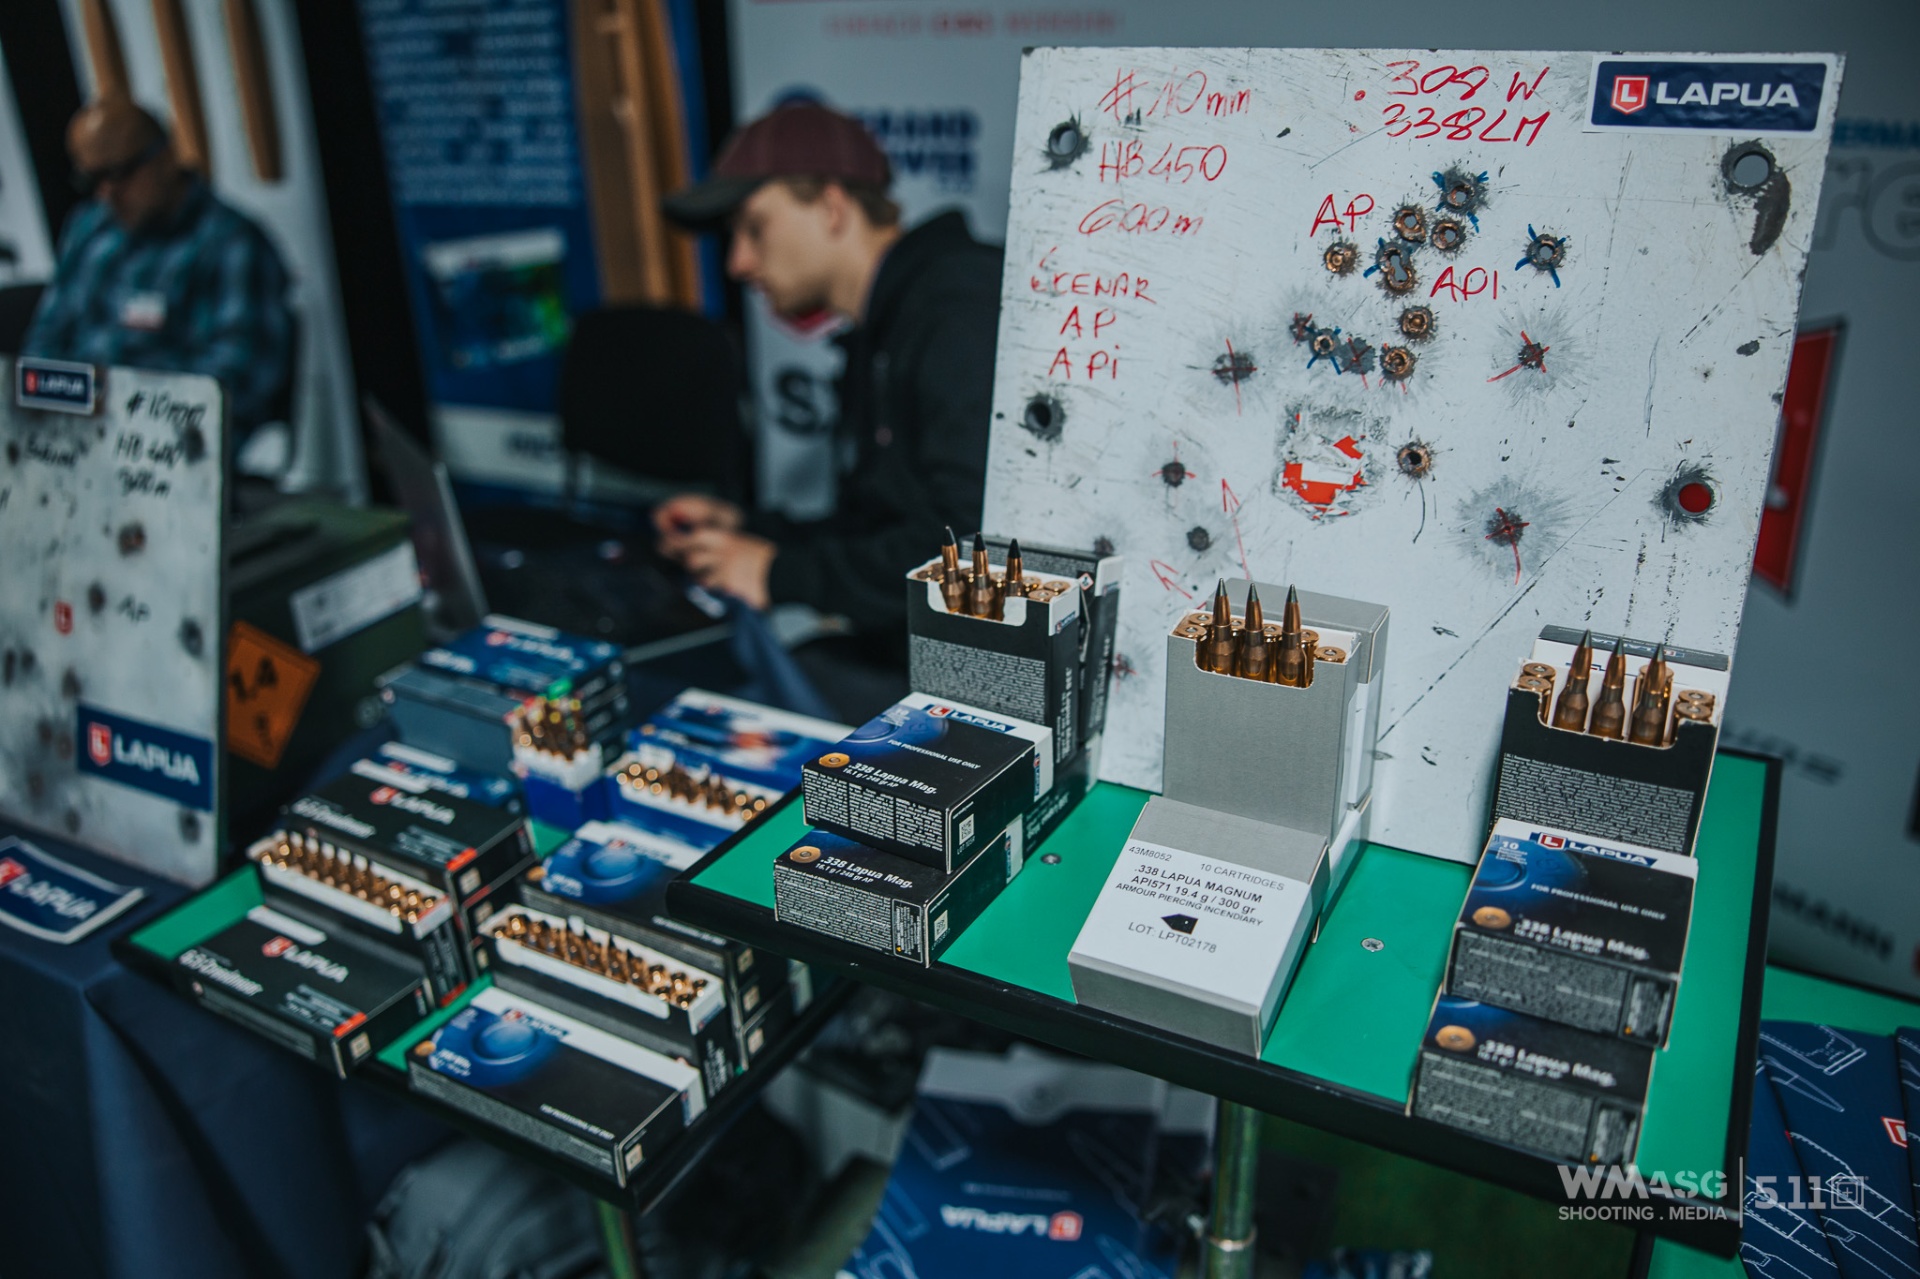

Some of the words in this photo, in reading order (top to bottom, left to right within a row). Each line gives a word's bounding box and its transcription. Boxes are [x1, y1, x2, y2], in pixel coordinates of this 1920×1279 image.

[1506, 66, 1550, 102] W
[1655, 81, 1800, 109] LAPUA
[1310, 193, 1375, 237] AP
[1430, 266, 1498, 301] API
[1060, 305, 1116, 338] AP
[951, 711, 1008, 733] LAPUA
[113, 733, 200, 786] LAPUA
[901, 743, 948, 761] PROFESSIONAL
[848, 762, 875, 774] .338
[873, 768, 909, 785] Lapua
[908, 779, 938, 794] Mag.
[1128, 846, 1173, 862] 43M8052
[1502, 840, 1519, 850] 10
[1568, 841, 1650, 866] LAPUA
[820, 856, 848, 868] .338
[846, 863, 884, 879] Lapua
[883, 873, 914, 888] Mag.
[1134, 864, 1160, 877] .338
[1160, 869, 1202, 888] LAPUA
[1204, 881, 1264, 904] MAGNUM
[1200, 863, 1213, 873] 10
[1213, 866, 1285, 892] CARTRIDGES
[1115, 882, 1157, 899] ARMOUR
[1157, 893, 1203, 911] PIERCING
[1203, 905, 1265, 927] INCENDIARY
[1130, 875, 1171, 892] API571
[1175, 886, 1199, 899] 19.4
[1200, 893, 1210, 904] g
[1218, 897, 1241, 911] 300
[1242, 904, 1257, 916] gr
[1127, 921, 1155, 938] LOT:
[1158, 929, 1219, 954] LPT02178
